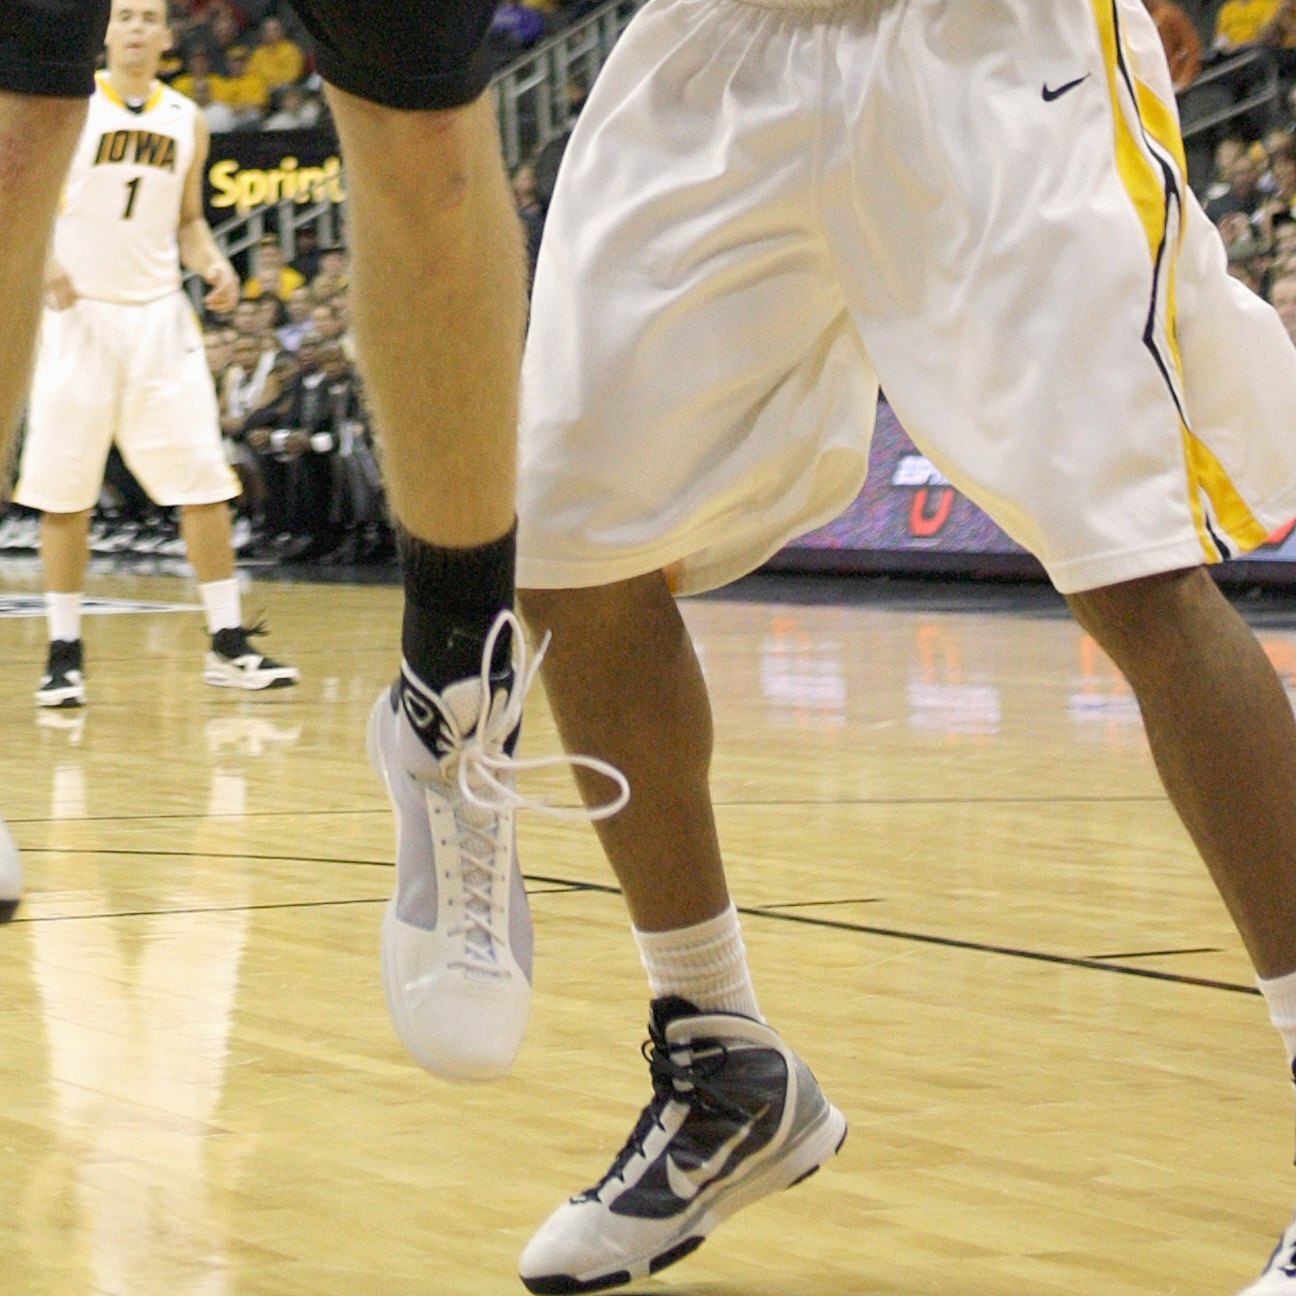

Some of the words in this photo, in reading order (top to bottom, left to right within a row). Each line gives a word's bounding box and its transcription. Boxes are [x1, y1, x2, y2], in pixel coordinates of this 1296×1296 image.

[92, 129, 177, 174] IOWA
[121, 175, 143, 222] 1
[208, 155, 346, 216] Sprint
